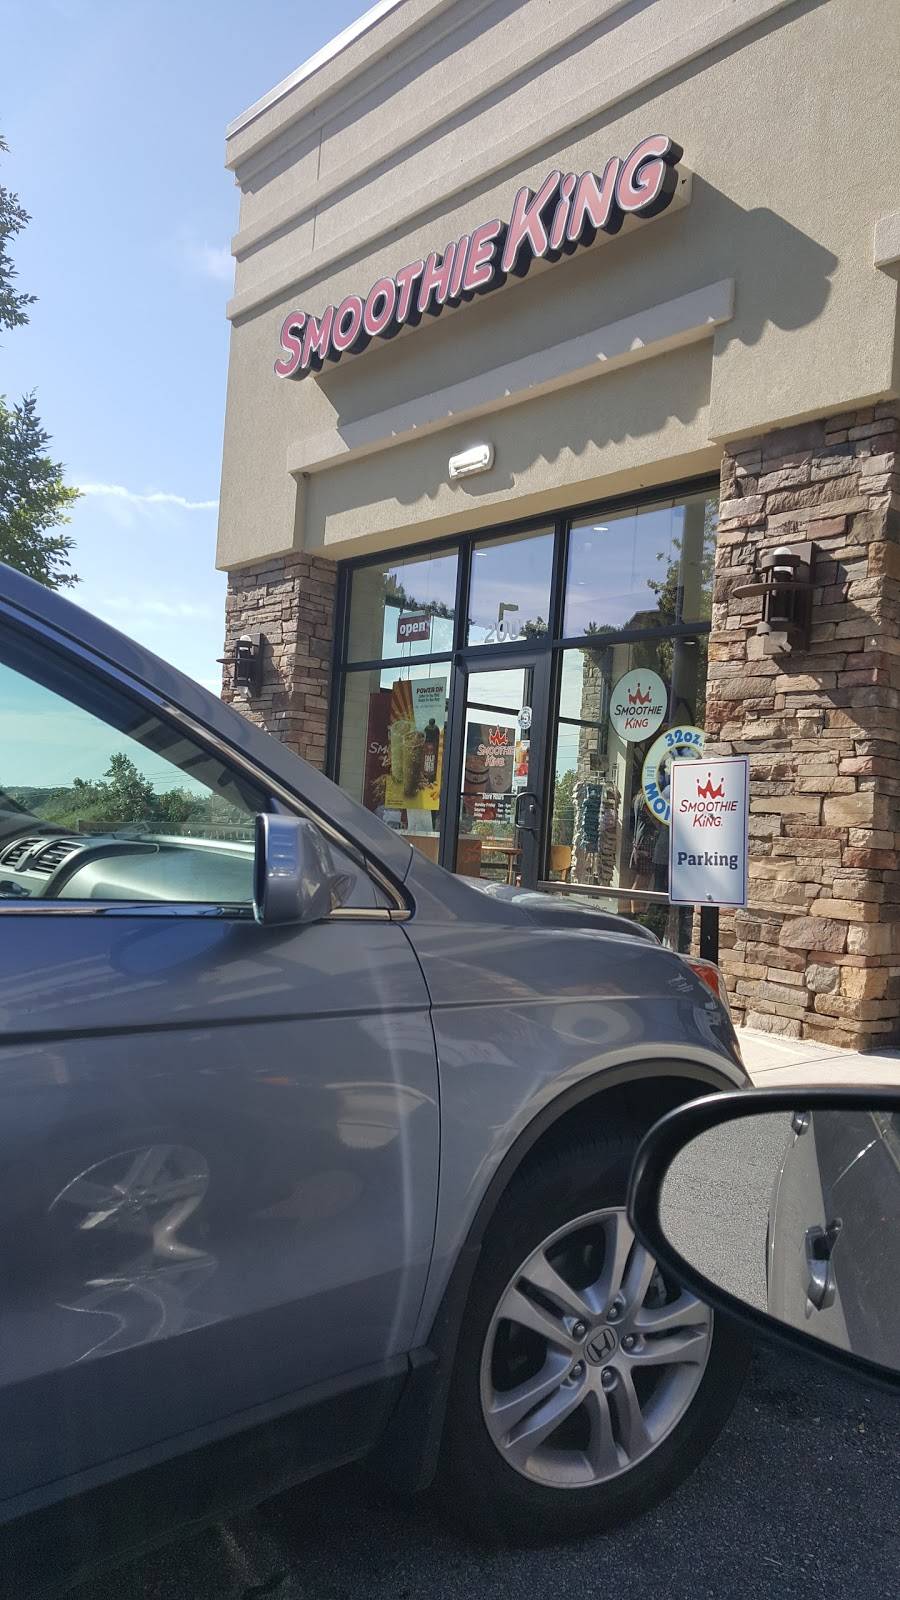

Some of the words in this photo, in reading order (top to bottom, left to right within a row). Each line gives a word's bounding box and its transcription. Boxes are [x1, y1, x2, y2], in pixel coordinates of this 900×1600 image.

[273, 217, 504, 379] SMOOTHIE
[399, 620, 427, 637] open
[485, 619, 521, 643] 200
[614, 704, 663, 716] SMOOTHIE
[679, 799, 739, 813] SMOOTHIE
[677, 851, 739, 871] Parking
